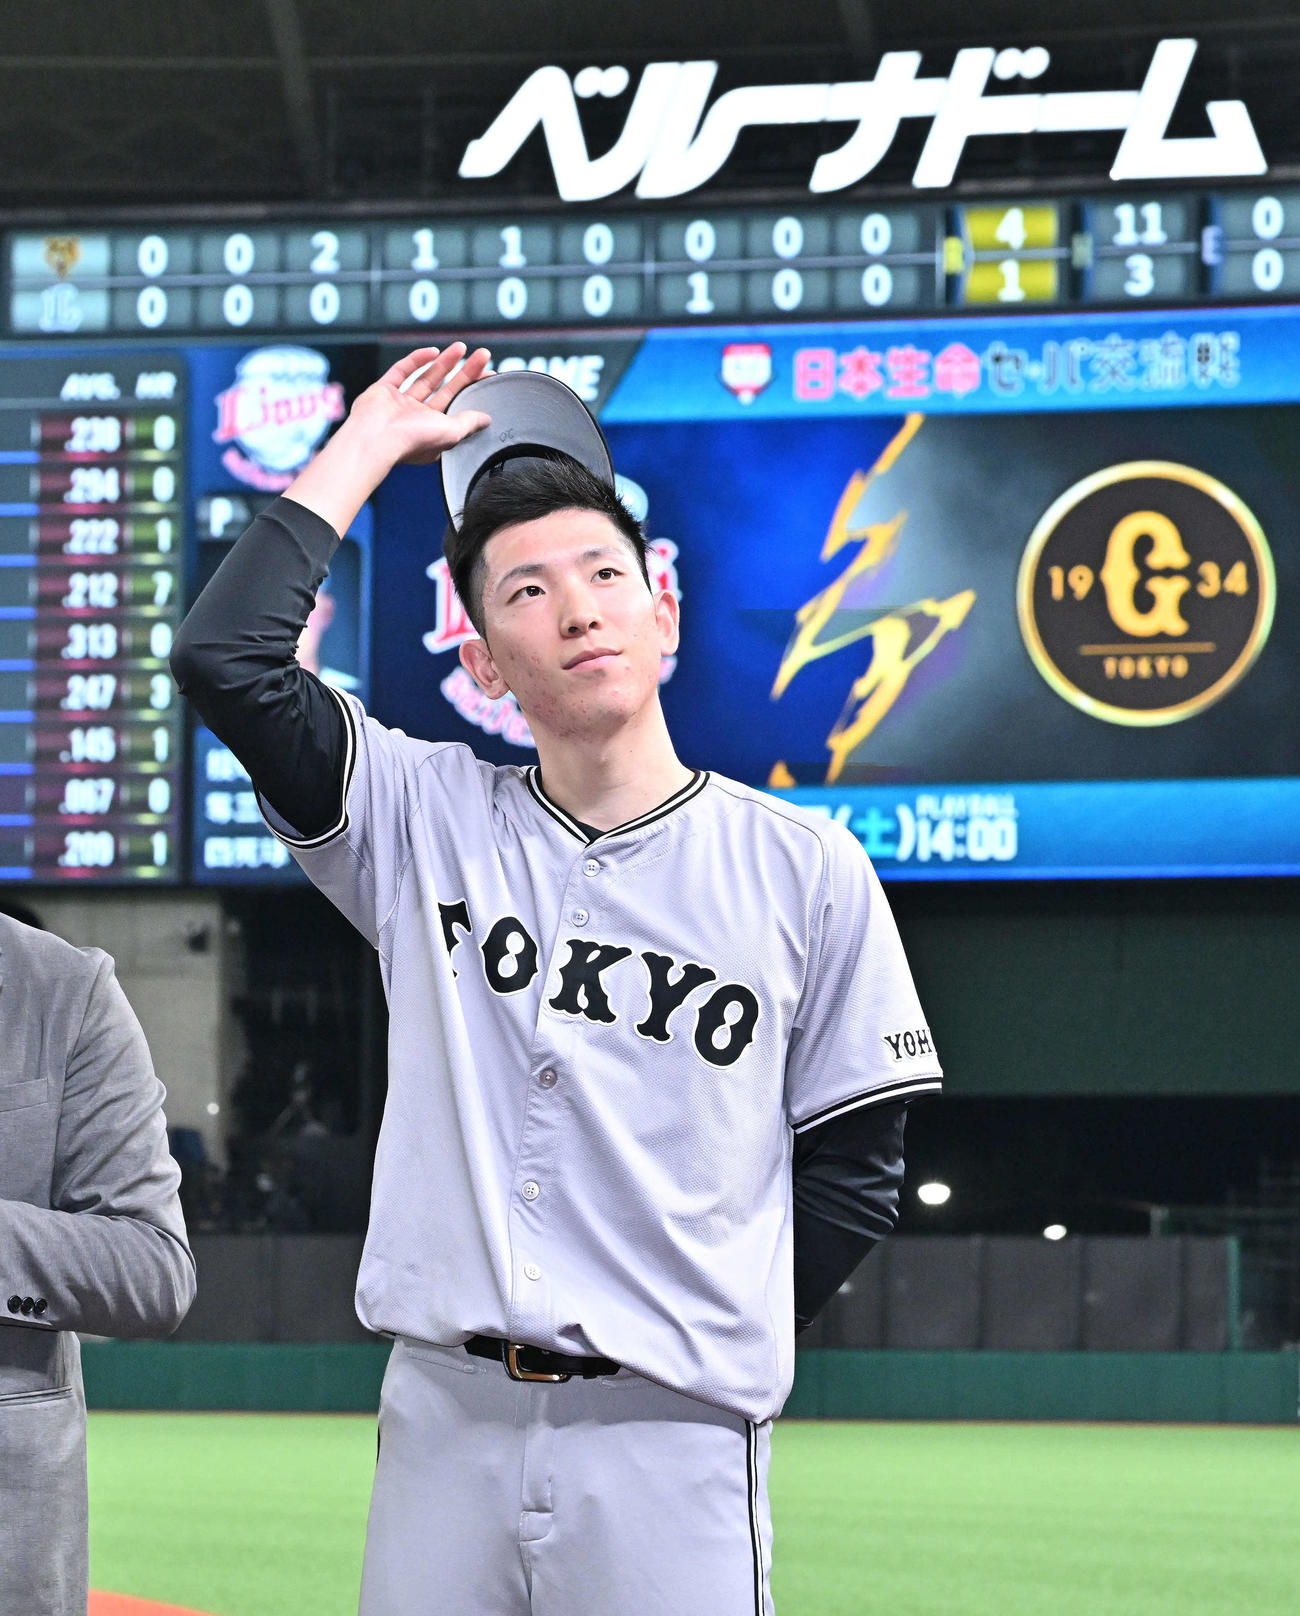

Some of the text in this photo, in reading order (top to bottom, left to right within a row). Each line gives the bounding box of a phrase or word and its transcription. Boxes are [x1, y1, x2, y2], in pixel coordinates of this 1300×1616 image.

[458, 38, 1268, 202] ベルーナドーム
[138, 198, 1283, 276] 0 0 2 1 1 0 0 0 0 4 11 0
[137, 249, 1283, 326] 0 0 0 0 0 0 1 0 0 1 3 0
[154, 415, 175, 451] 0
[153, 466, 174, 502] 0
[156, 517, 172, 553] 1
[210, 497, 233, 537] P
[152, 571, 172, 607] 7
[1049, 509, 1248, 637] 19 G 34
[151, 623, 172, 658] 0
[1103, 654, 1189, 680] TOKYO
[150, 673, 171, 709] 3
[152, 726, 168, 762] 1
[148, 778, 170, 814] 0
[151, 831, 167, 867] 1
